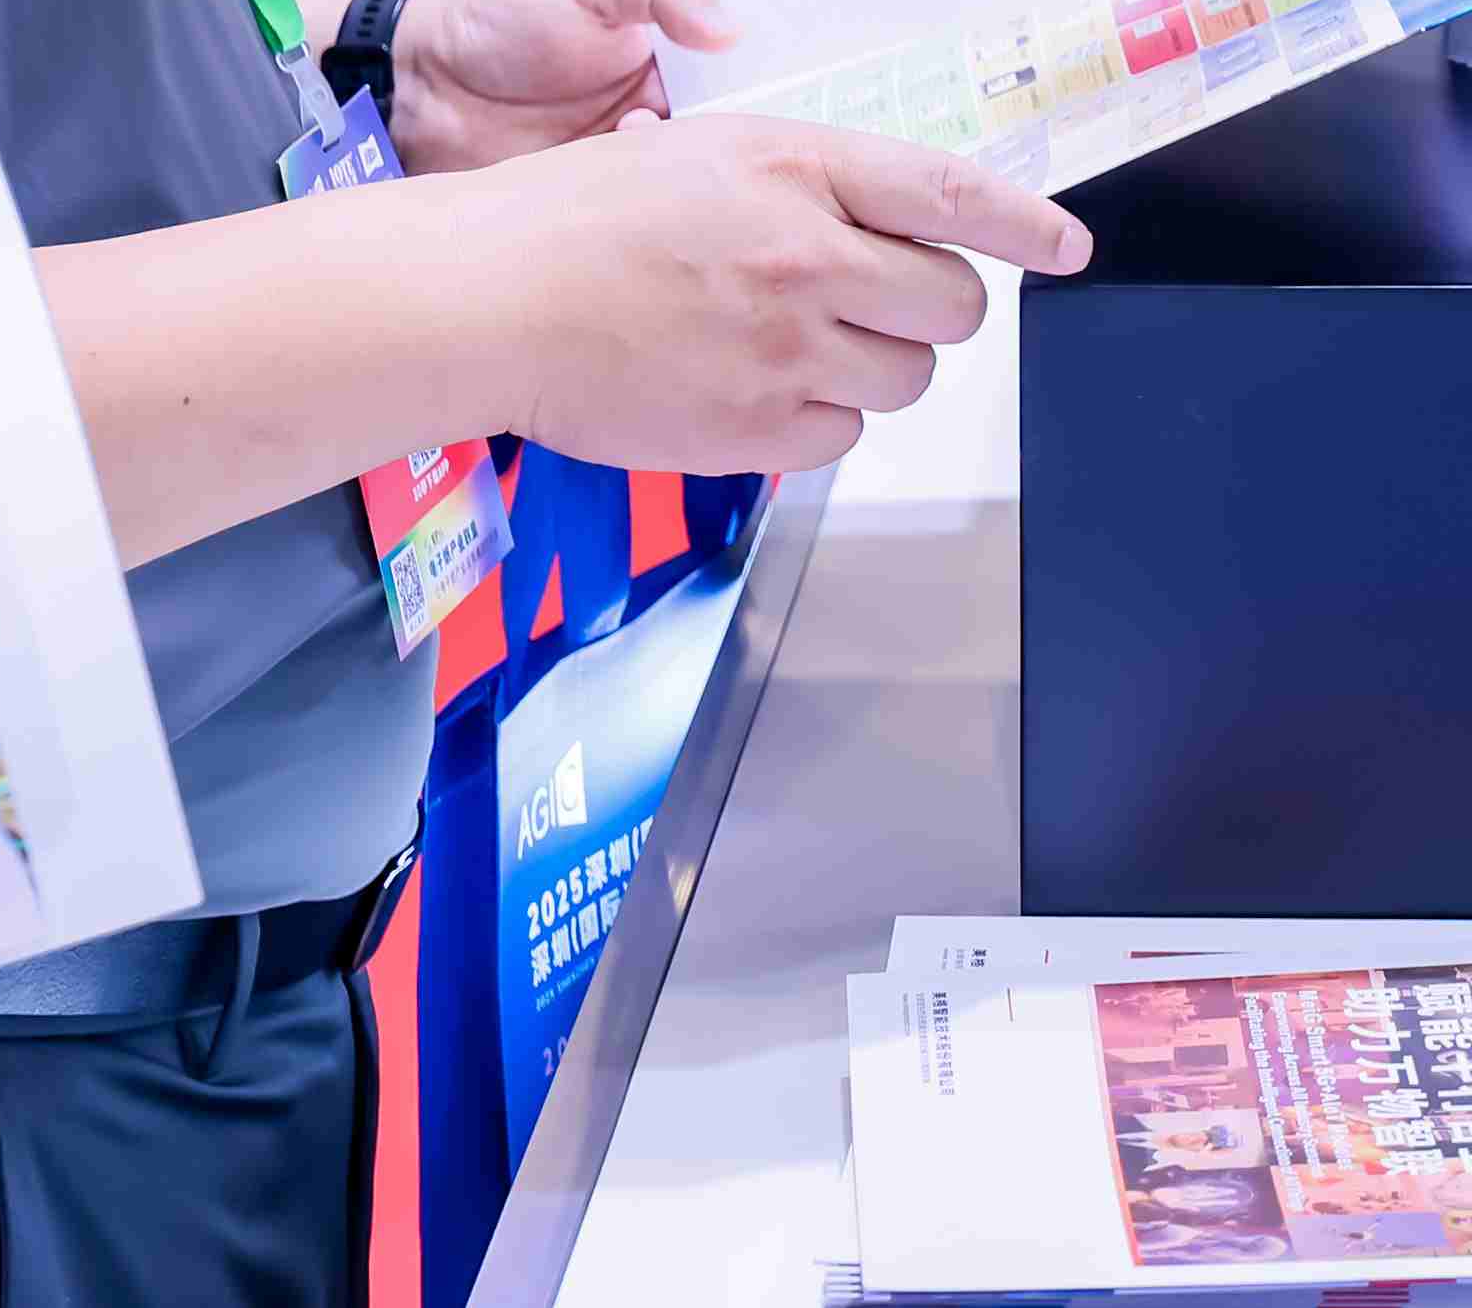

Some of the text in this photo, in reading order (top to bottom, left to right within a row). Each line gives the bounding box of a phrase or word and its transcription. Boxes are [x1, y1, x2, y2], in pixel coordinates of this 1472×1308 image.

[1241, 991, 1268, 1050] Facilitating
[1306, 1025, 1331, 1066] Smart
[1342, 987, 1446, 1177] 助力万物智联
